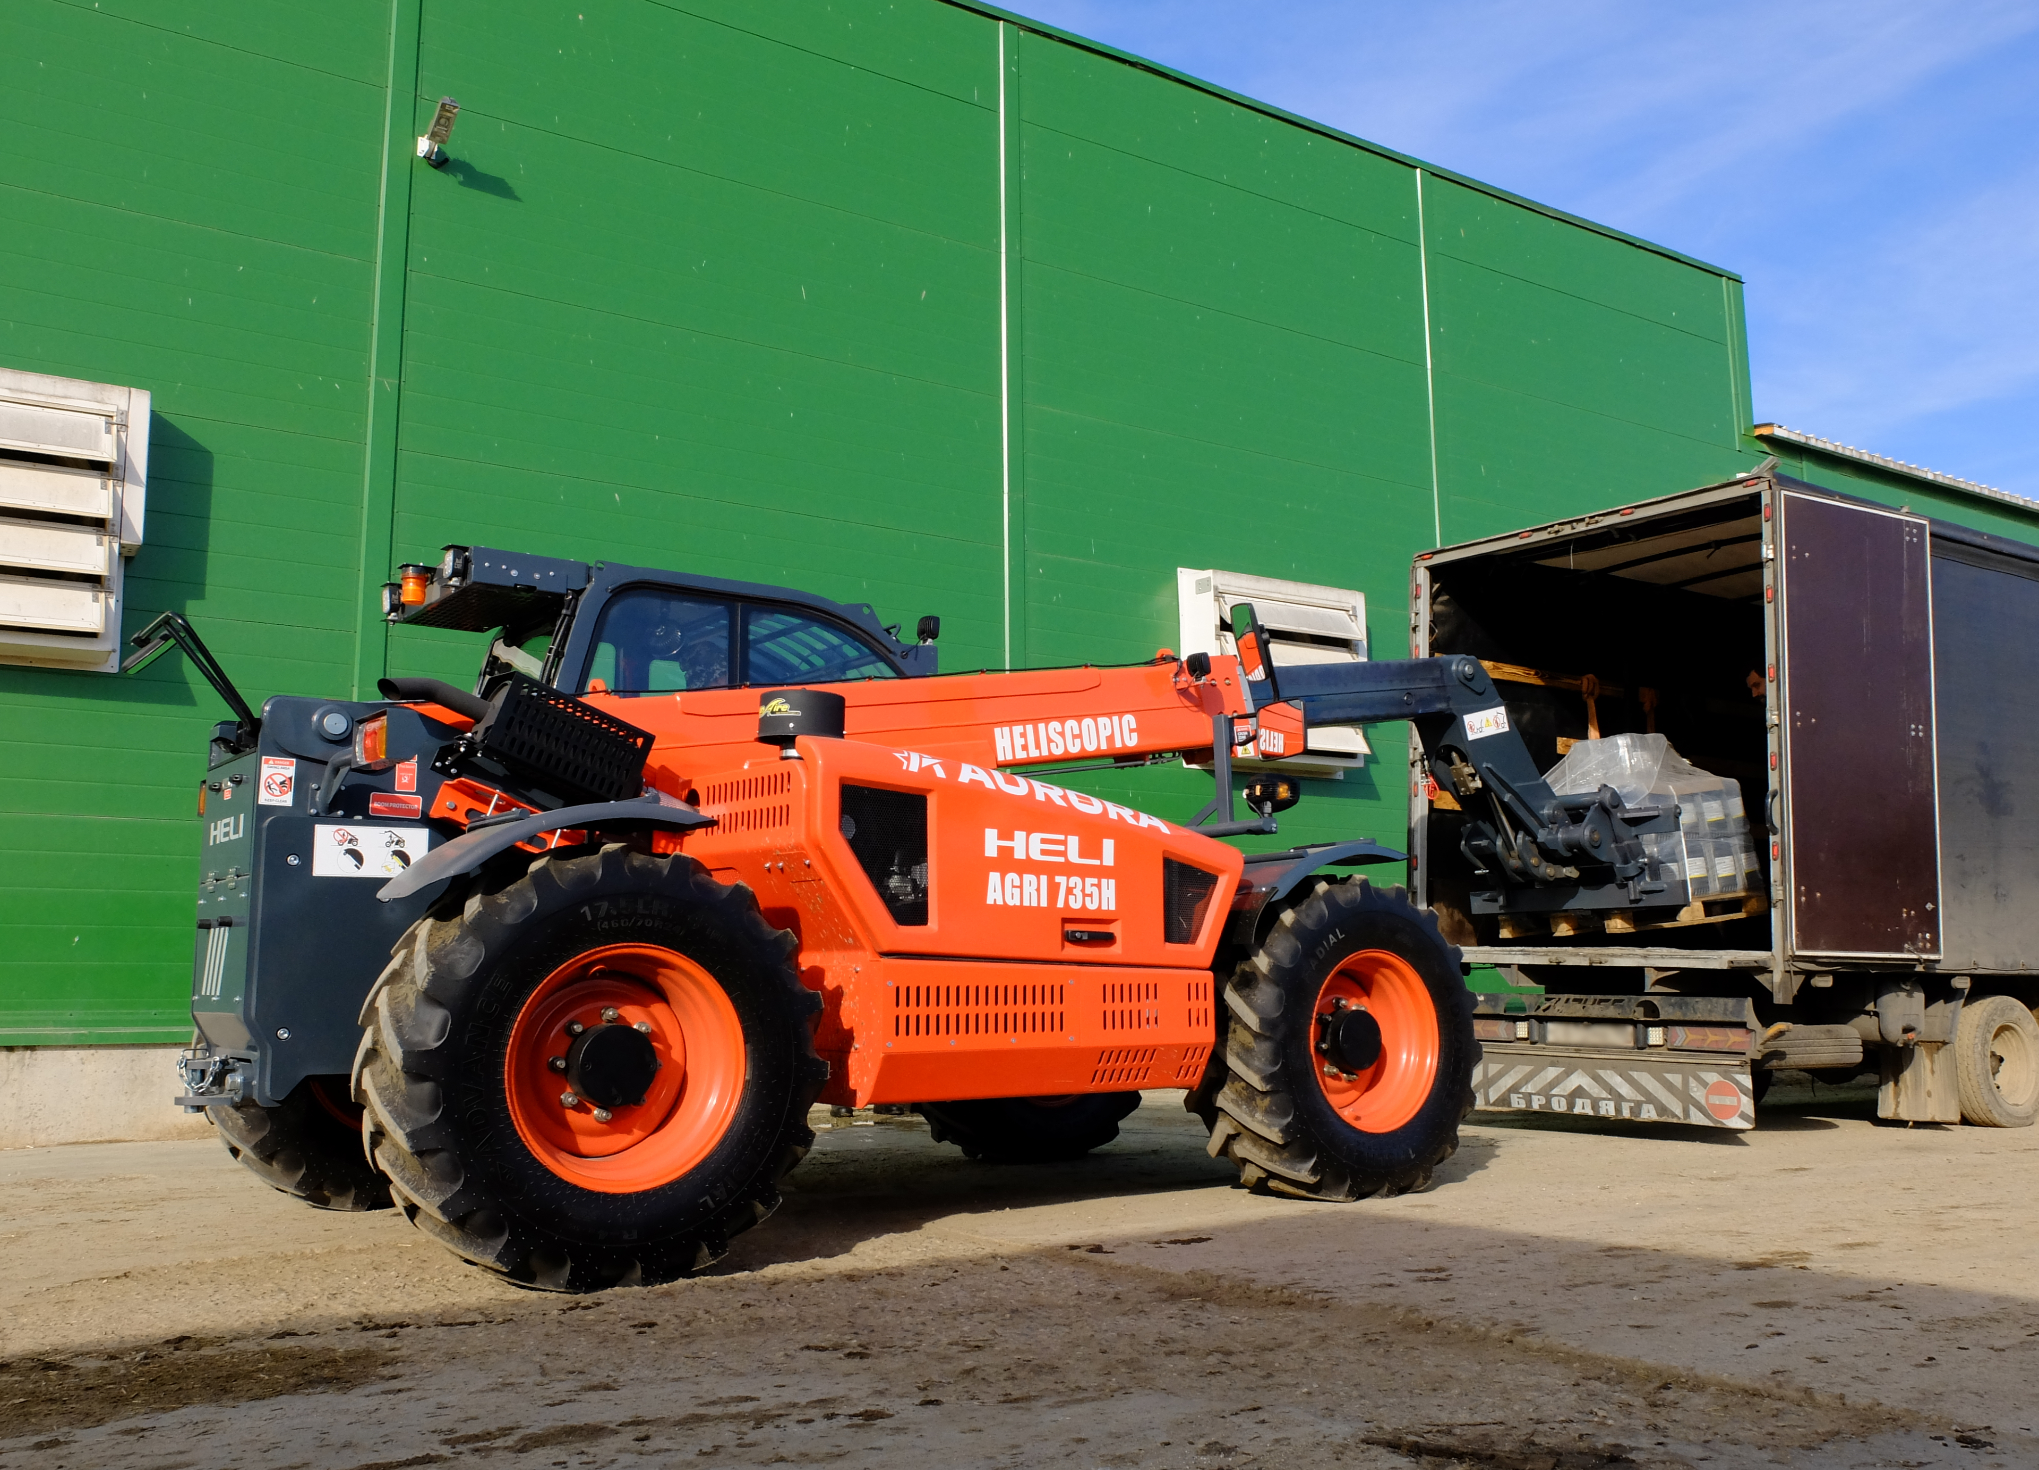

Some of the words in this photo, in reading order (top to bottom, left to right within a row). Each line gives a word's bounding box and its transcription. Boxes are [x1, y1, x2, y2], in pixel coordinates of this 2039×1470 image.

[994, 714, 1138, 761] HELISCOPIC
[390, 802, 418, 810] PROTECTOR
[958, 763, 1171, 834] AURORA
[209, 813, 244, 846] HELI
[985, 828, 1115, 866] HELI
[986, 872, 1048, 907] AGRI
[1055, 875, 1116, 911] 735H
[460, 972, 513, 1157] ADVANCE
[1510, 1093, 1659, 1119] БРОДЯГА
